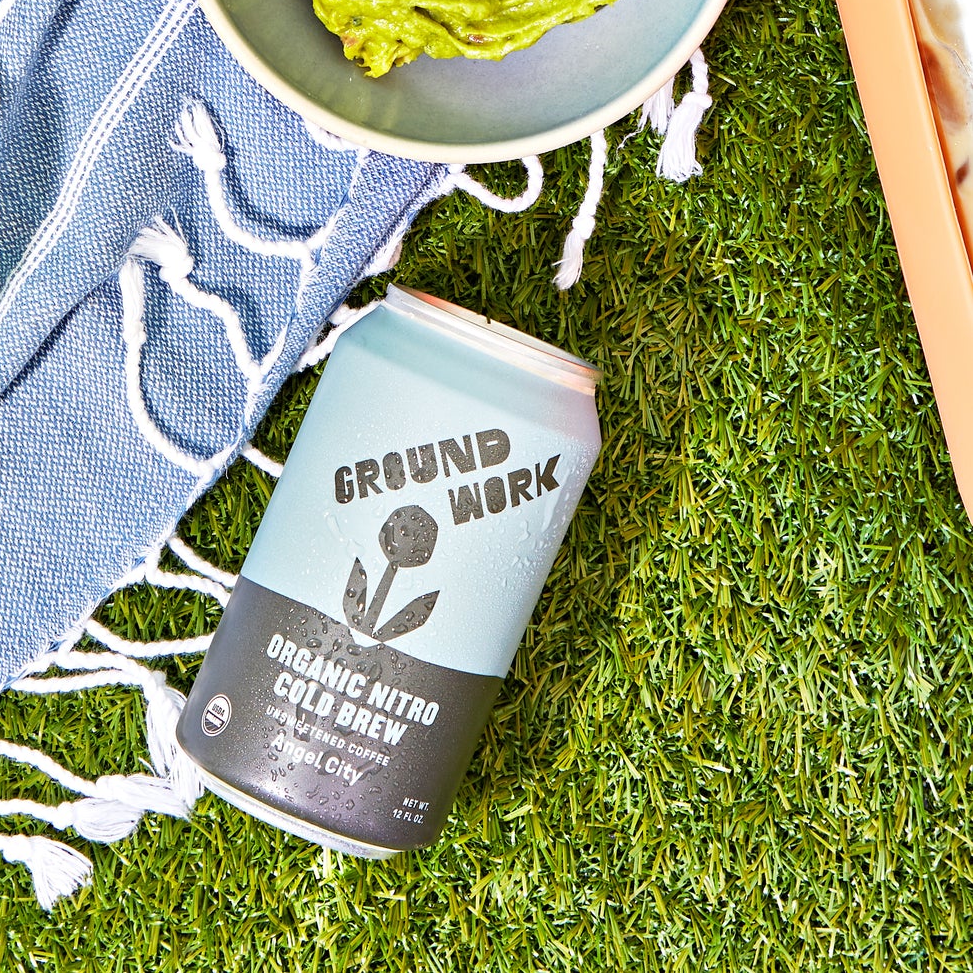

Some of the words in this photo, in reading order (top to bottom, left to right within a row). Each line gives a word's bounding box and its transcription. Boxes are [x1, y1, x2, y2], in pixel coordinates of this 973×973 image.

[334, 428, 511, 505] GROUND
[447, 453, 561, 526] WORK
[266, 633, 367, 700] ORGANIC
[366, 682, 440, 726] NITRO
[273, 671, 335, 717] COLD
[335, 700, 409, 746] BREW
[265, 704, 347, 749] UNSWEETENED
[347, 742, 391, 767] COFFEE
[270, 732, 323, 770] Angel
[324, 756, 365, 787] City
[392, 808, 403, 819] 12
[403, 811, 413, 822] FL
[413, 813, 424, 824] OZ.
[402, 797, 418, 808] NET
[418, 801, 430, 811] WT.
